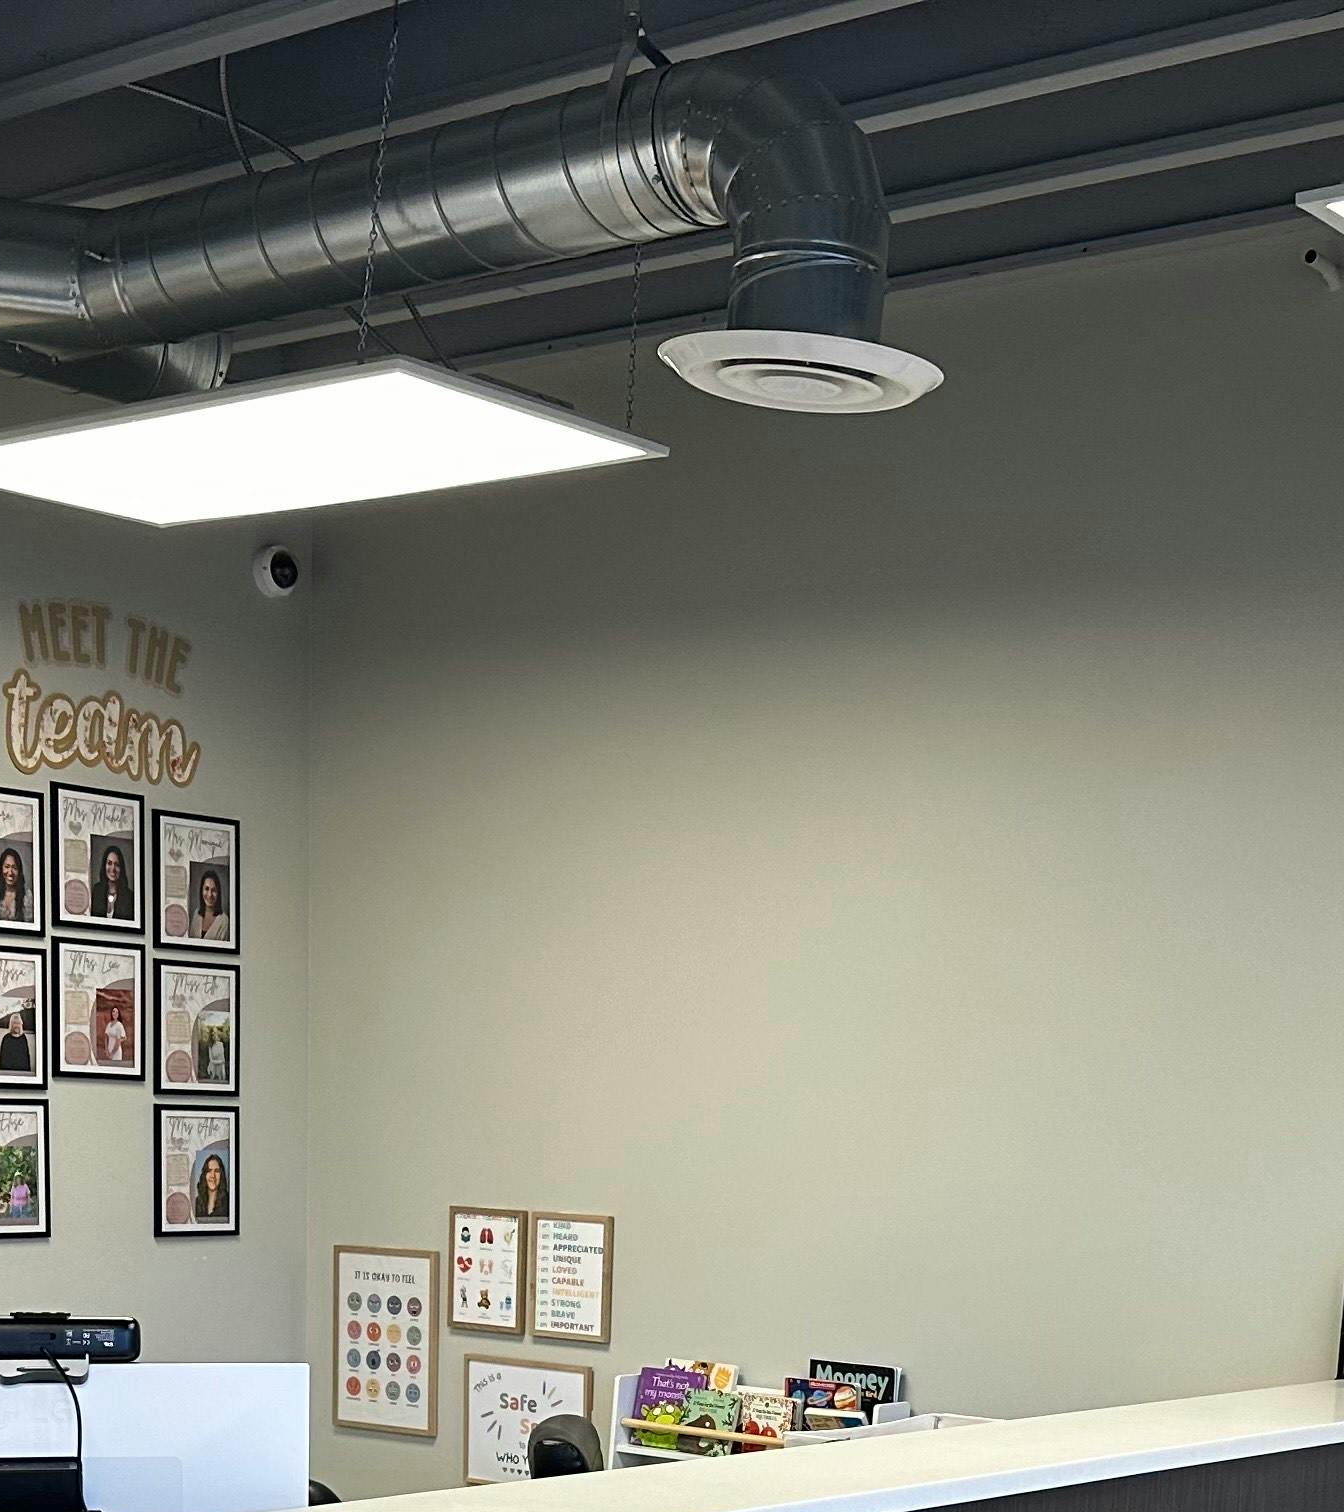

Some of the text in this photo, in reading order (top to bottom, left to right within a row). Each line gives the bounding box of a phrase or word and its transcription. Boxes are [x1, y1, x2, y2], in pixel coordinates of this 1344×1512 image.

[18, 600, 193, 696] MEET THE
[2, 669, 201, 787] team
[553, 1233, 578, 1241] HEARD
[553, 1244, 604, 1254] APPRECIATED
[553, 1255, 582, 1264] UNIQUE
[552, 1266, 577, 1274] LOVED
[354, 1270, 417, 1284] IT IS OKAY TO FEEL
[552, 1277, 584, 1287] CAPABLE
[551, 1299, 581, 1308] STRONG
[551, 1310, 576, 1319] BRAVE
[551, 1321, 594, 1332] IMPORTANT
[473, 1378, 488, 1392] THIS
[488, 1373, 495, 1383] IS
[652, 1376, 690, 1390] That's not
[644, 1389, 657, 1399] my
[499, 1392, 537, 1413] Safe
[496, 1451, 519, 1464] WHO
